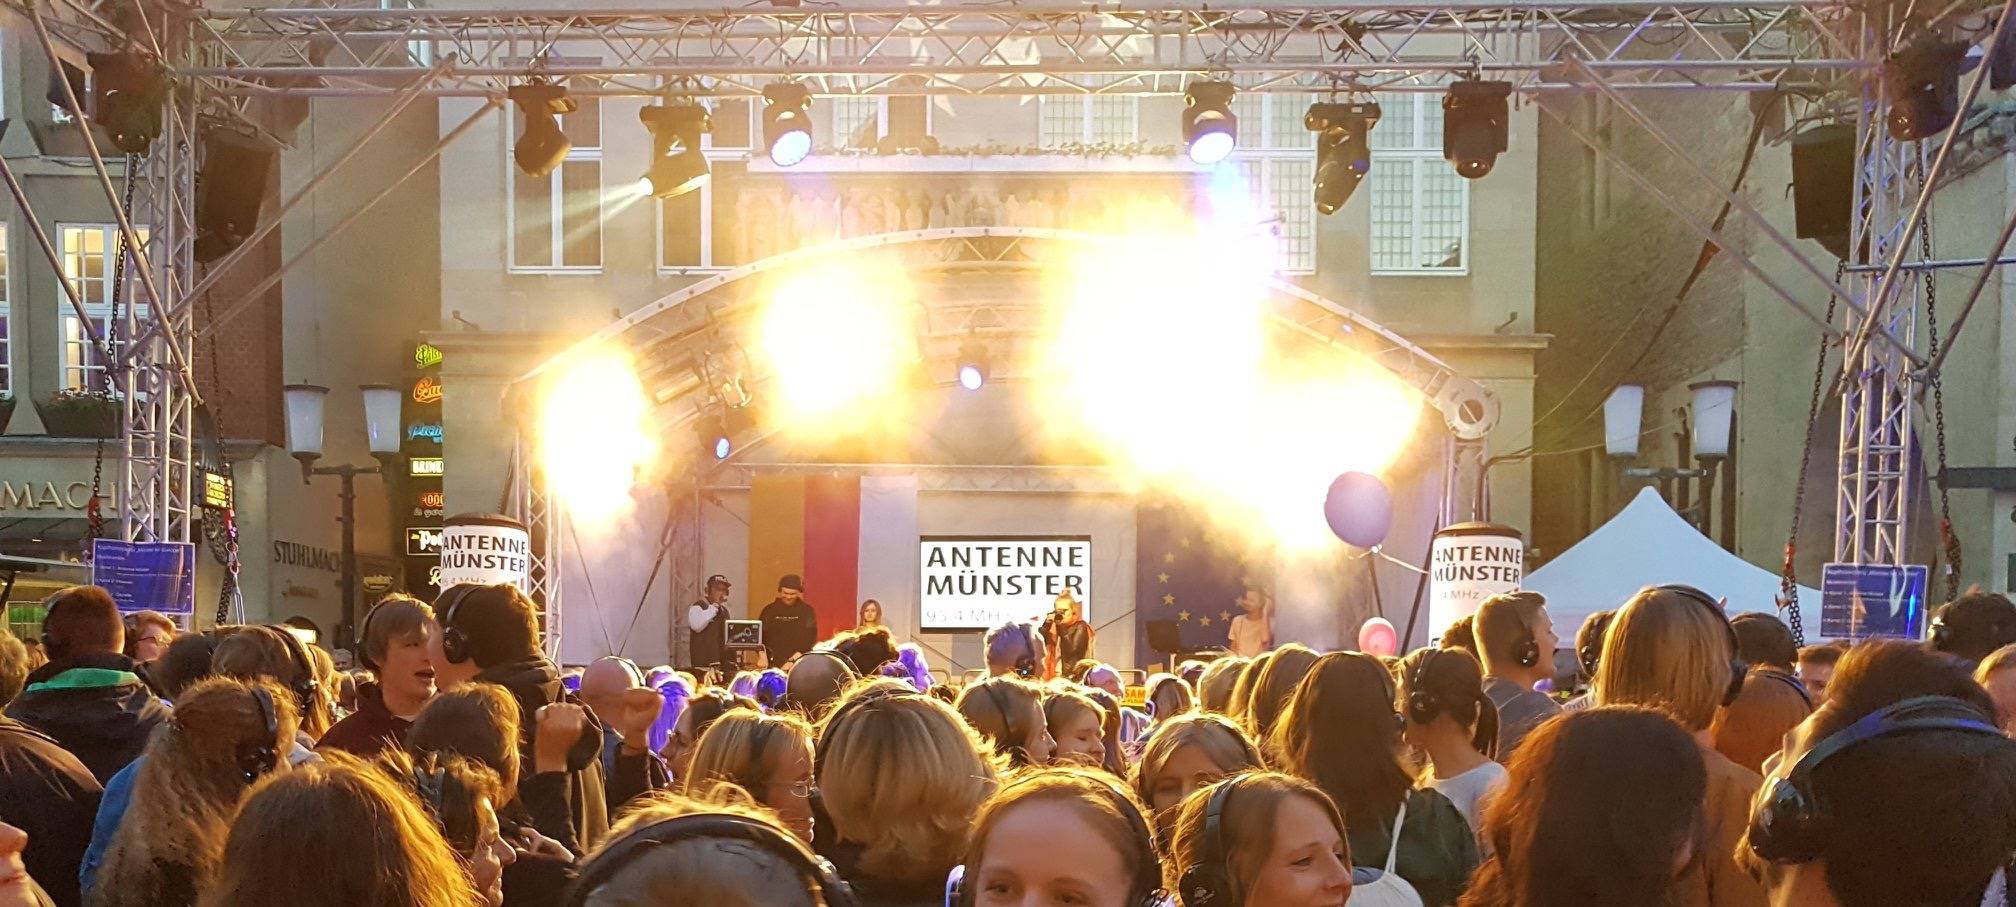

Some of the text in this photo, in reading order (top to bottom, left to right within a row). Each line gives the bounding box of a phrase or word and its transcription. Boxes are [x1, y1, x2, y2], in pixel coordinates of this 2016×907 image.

[0, 481, 141, 510] MACH
[443, 534, 526, 556] ANTENNE
[442, 551, 525, 573] MÜNSTER
[927, 547, 1083, 567] ANTENNE
[927, 570, 1083, 595] MÜNSTER
[1435, 563, 1520, 584] MÜNSTER
[971, 609, 1009, 622] MH
